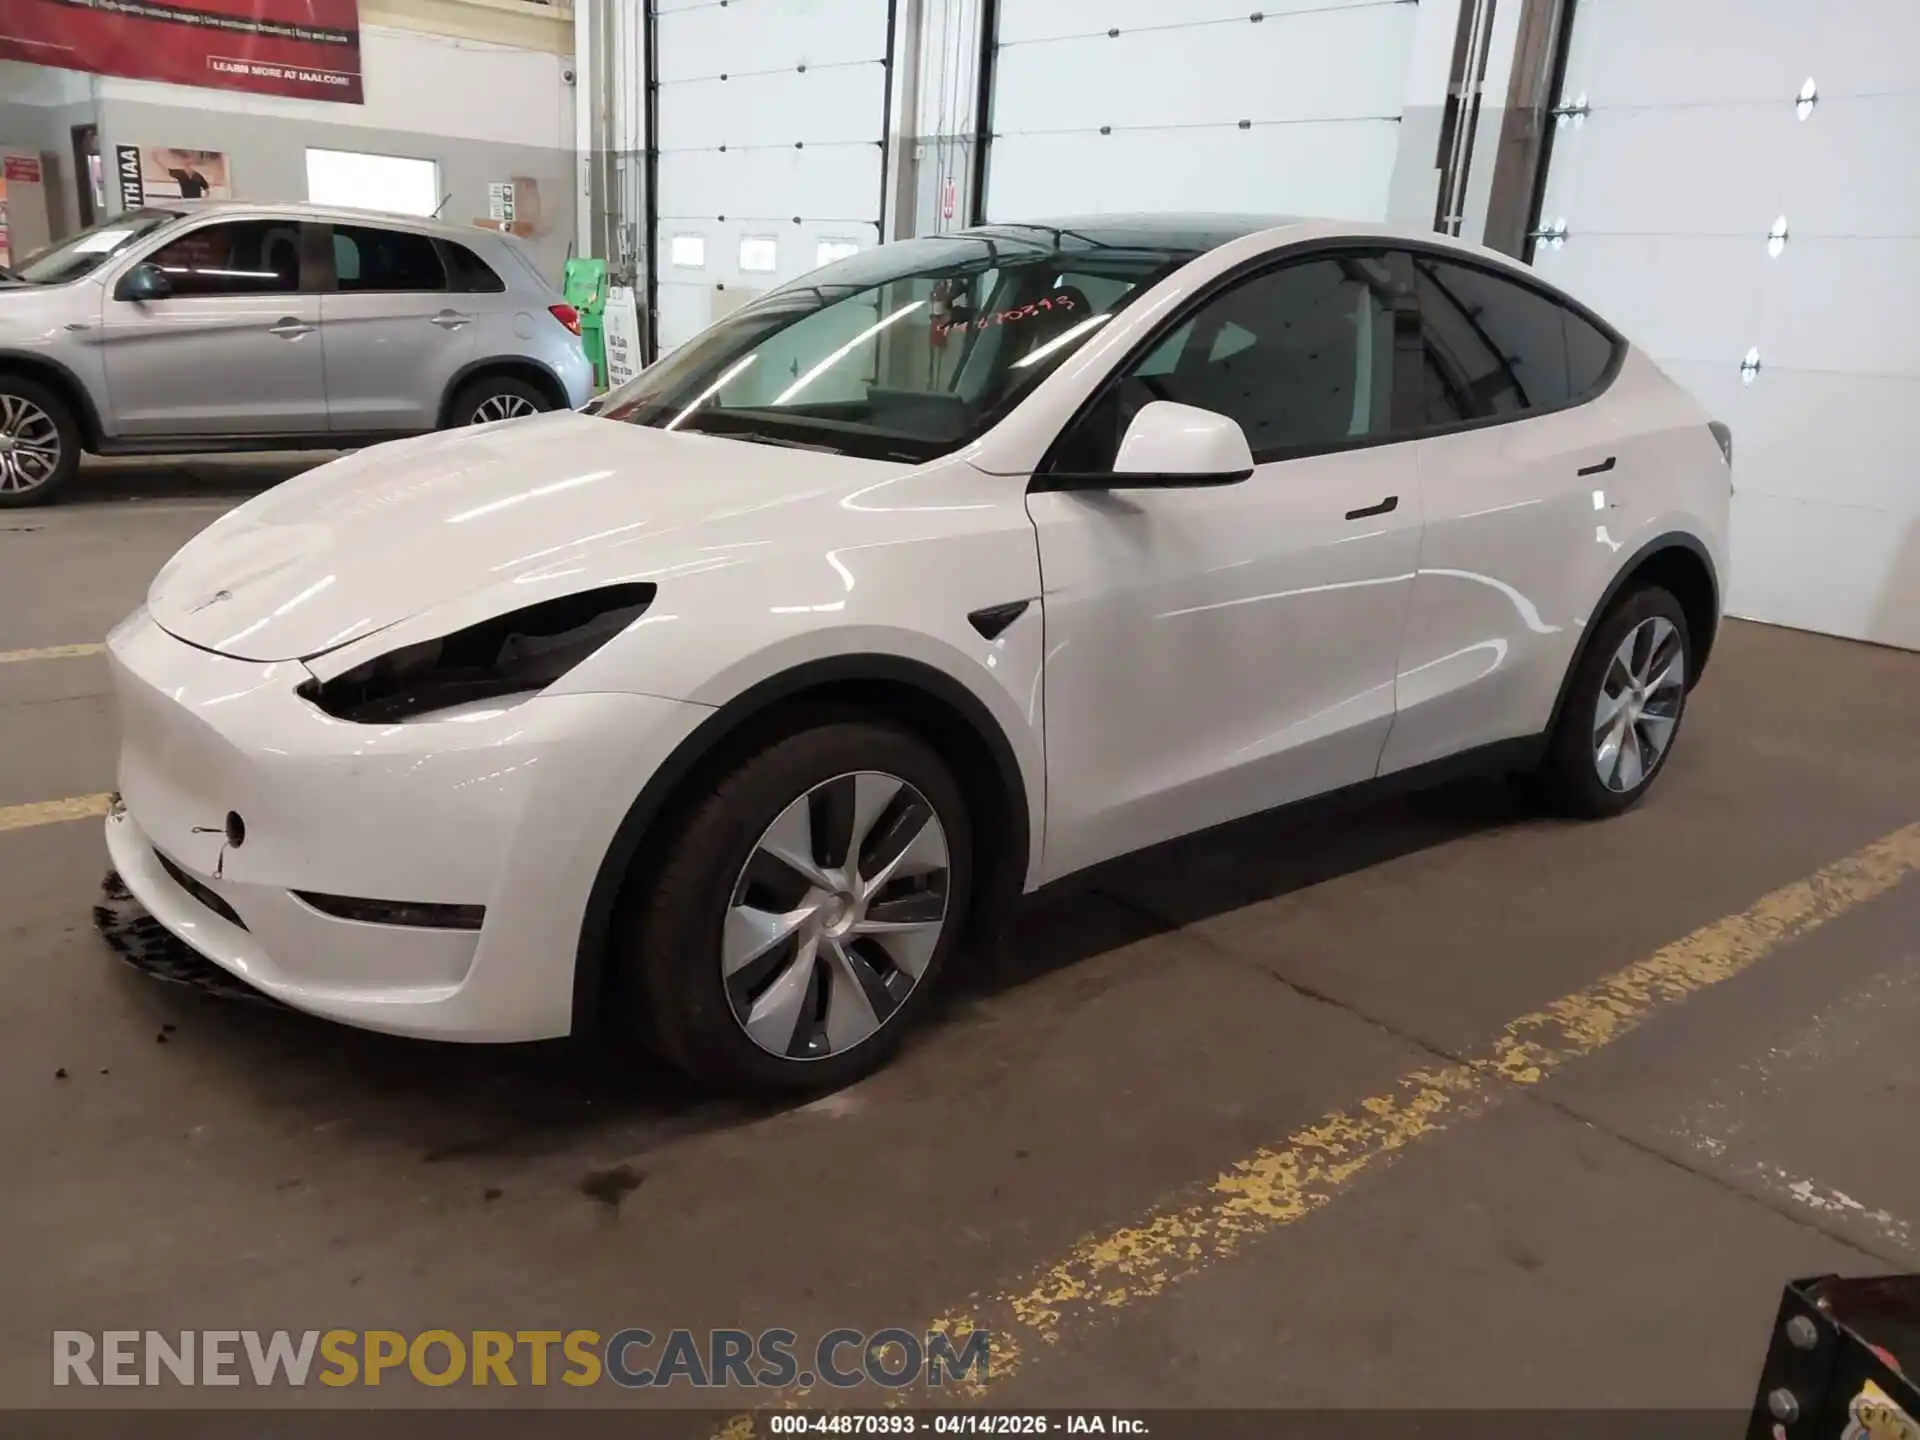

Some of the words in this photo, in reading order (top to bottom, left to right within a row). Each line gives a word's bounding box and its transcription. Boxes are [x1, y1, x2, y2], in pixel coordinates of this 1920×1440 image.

[213, 61, 249, 74] LEARN
[251, 65, 282, 78] MORE
[284, 69, 297, 80] AT
[120, 150, 139, 178] IAA
[123, 182, 141, 211] ITH
